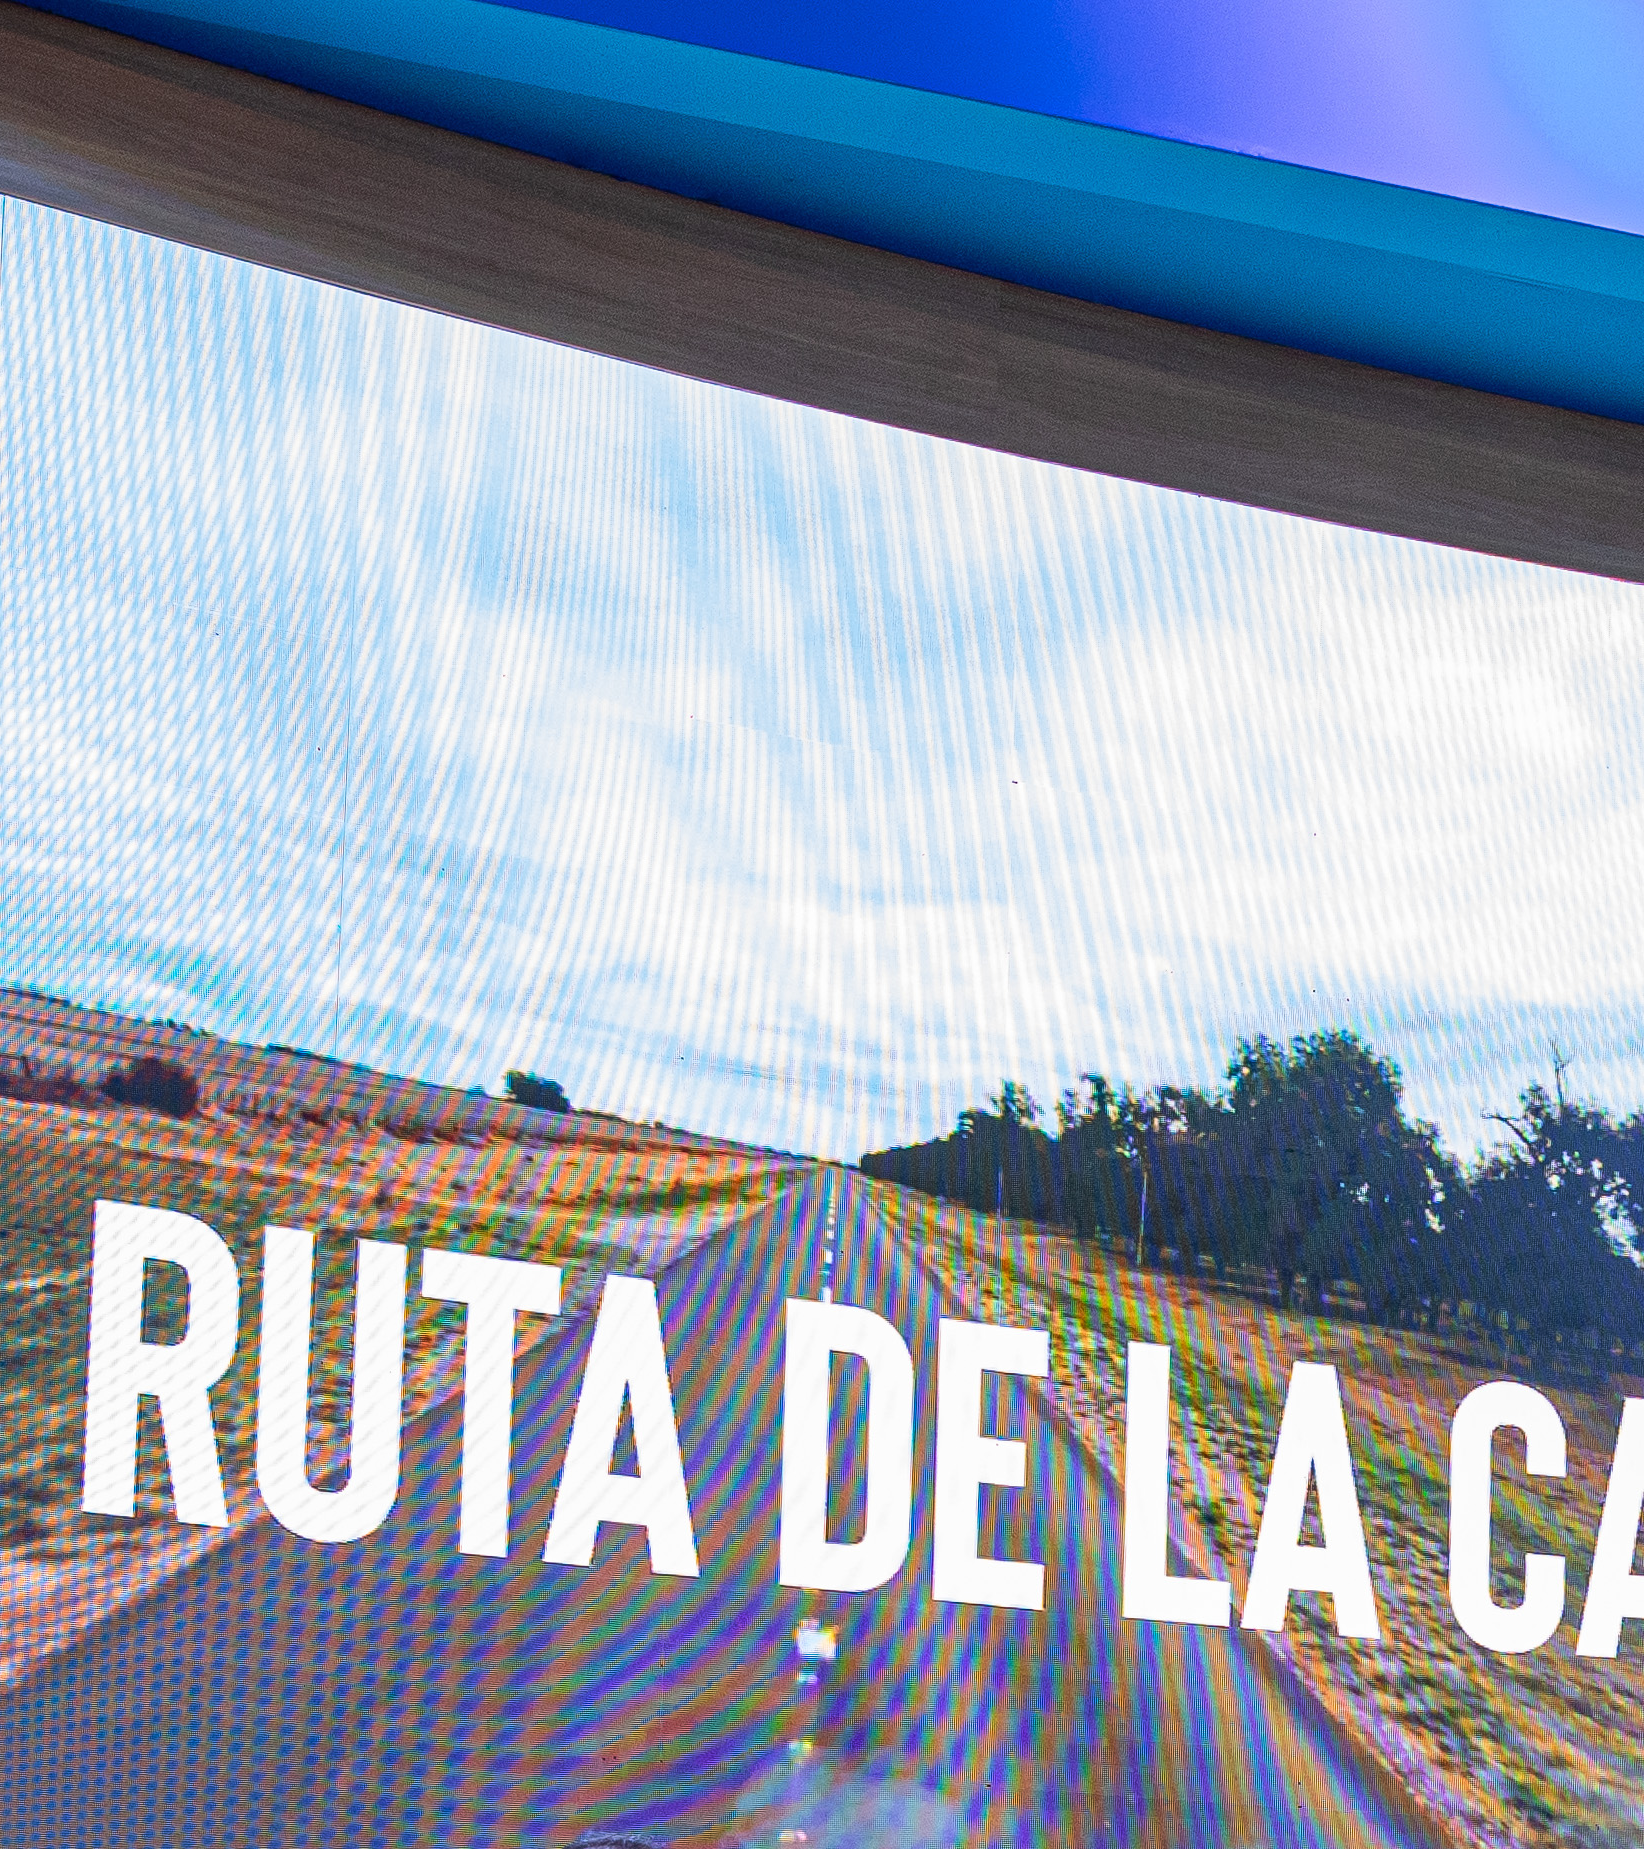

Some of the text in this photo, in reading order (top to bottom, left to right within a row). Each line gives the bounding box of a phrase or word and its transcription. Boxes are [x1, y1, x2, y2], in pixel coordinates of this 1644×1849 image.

[81, 1199, 702, 1578] RUTA
[779, 1297, 1050, 1610] DE
[1122, 1341, 1382, 1642] LA
